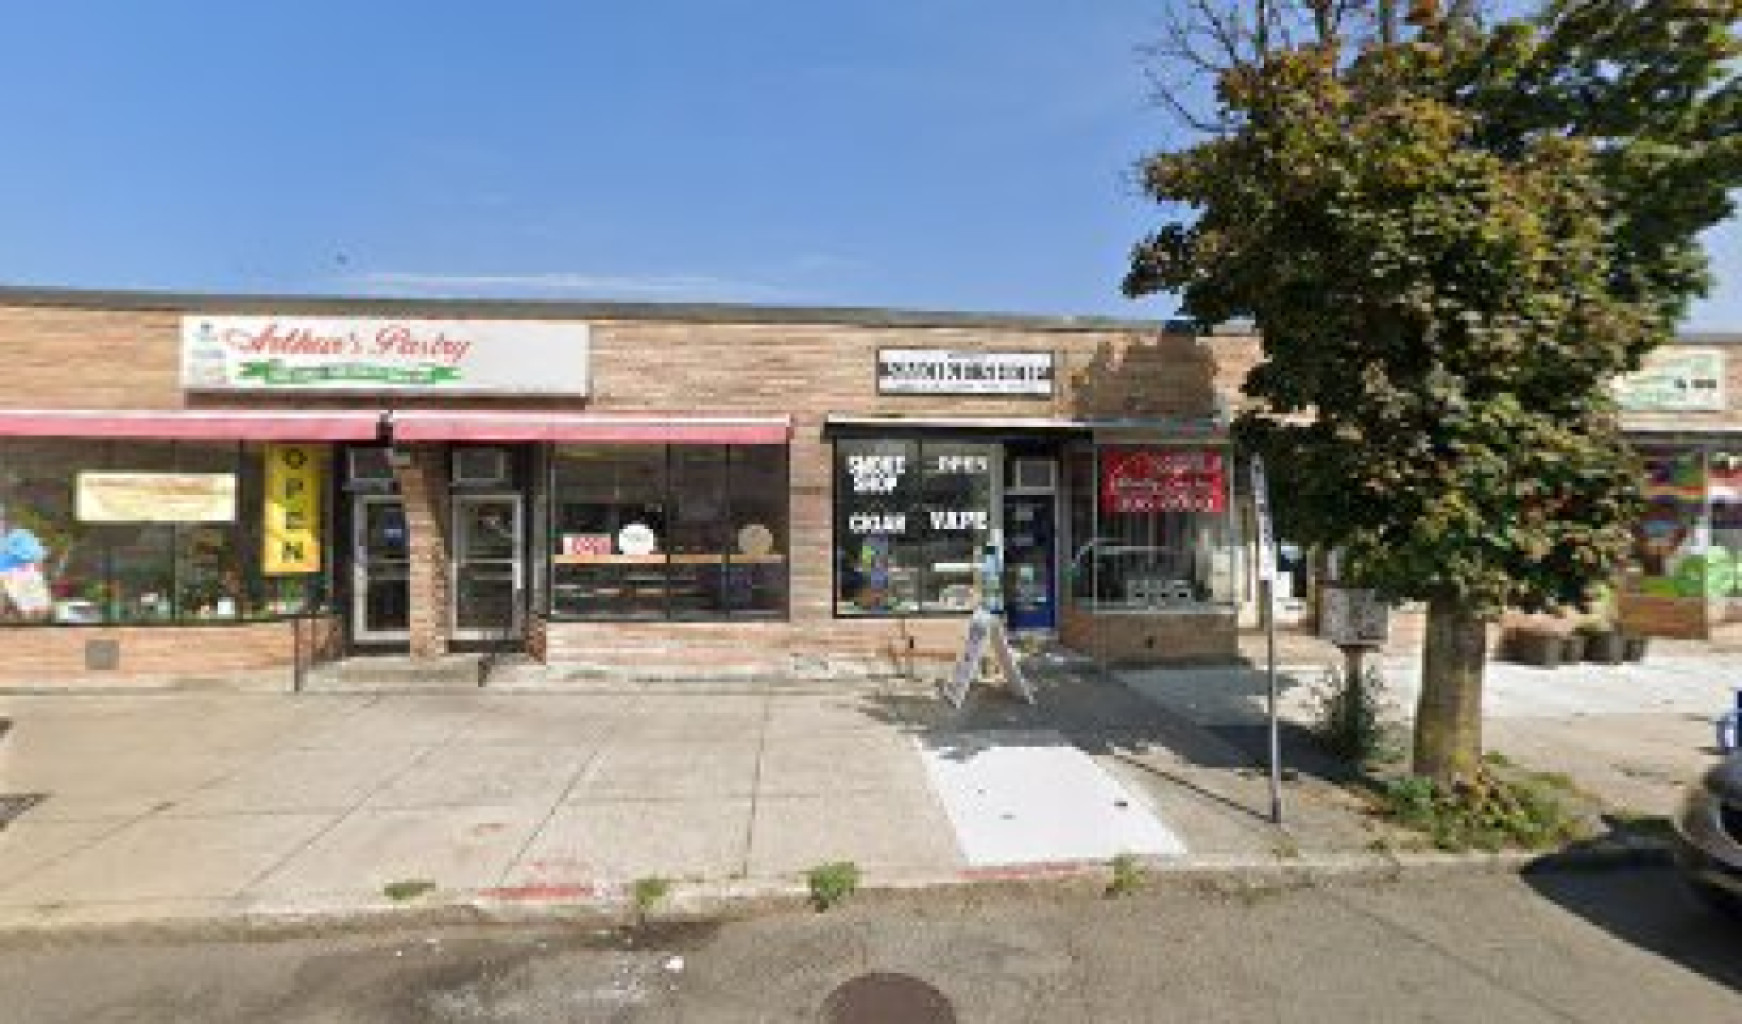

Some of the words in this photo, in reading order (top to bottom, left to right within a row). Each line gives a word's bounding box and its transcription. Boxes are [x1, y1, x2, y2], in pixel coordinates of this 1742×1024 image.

[225, 323, 362, 356] Arthur's
[371, 325, 472, 362] Pastry
[281, 447, 308, 564] OPEN
[929, 511, 988, 530] VAPE
